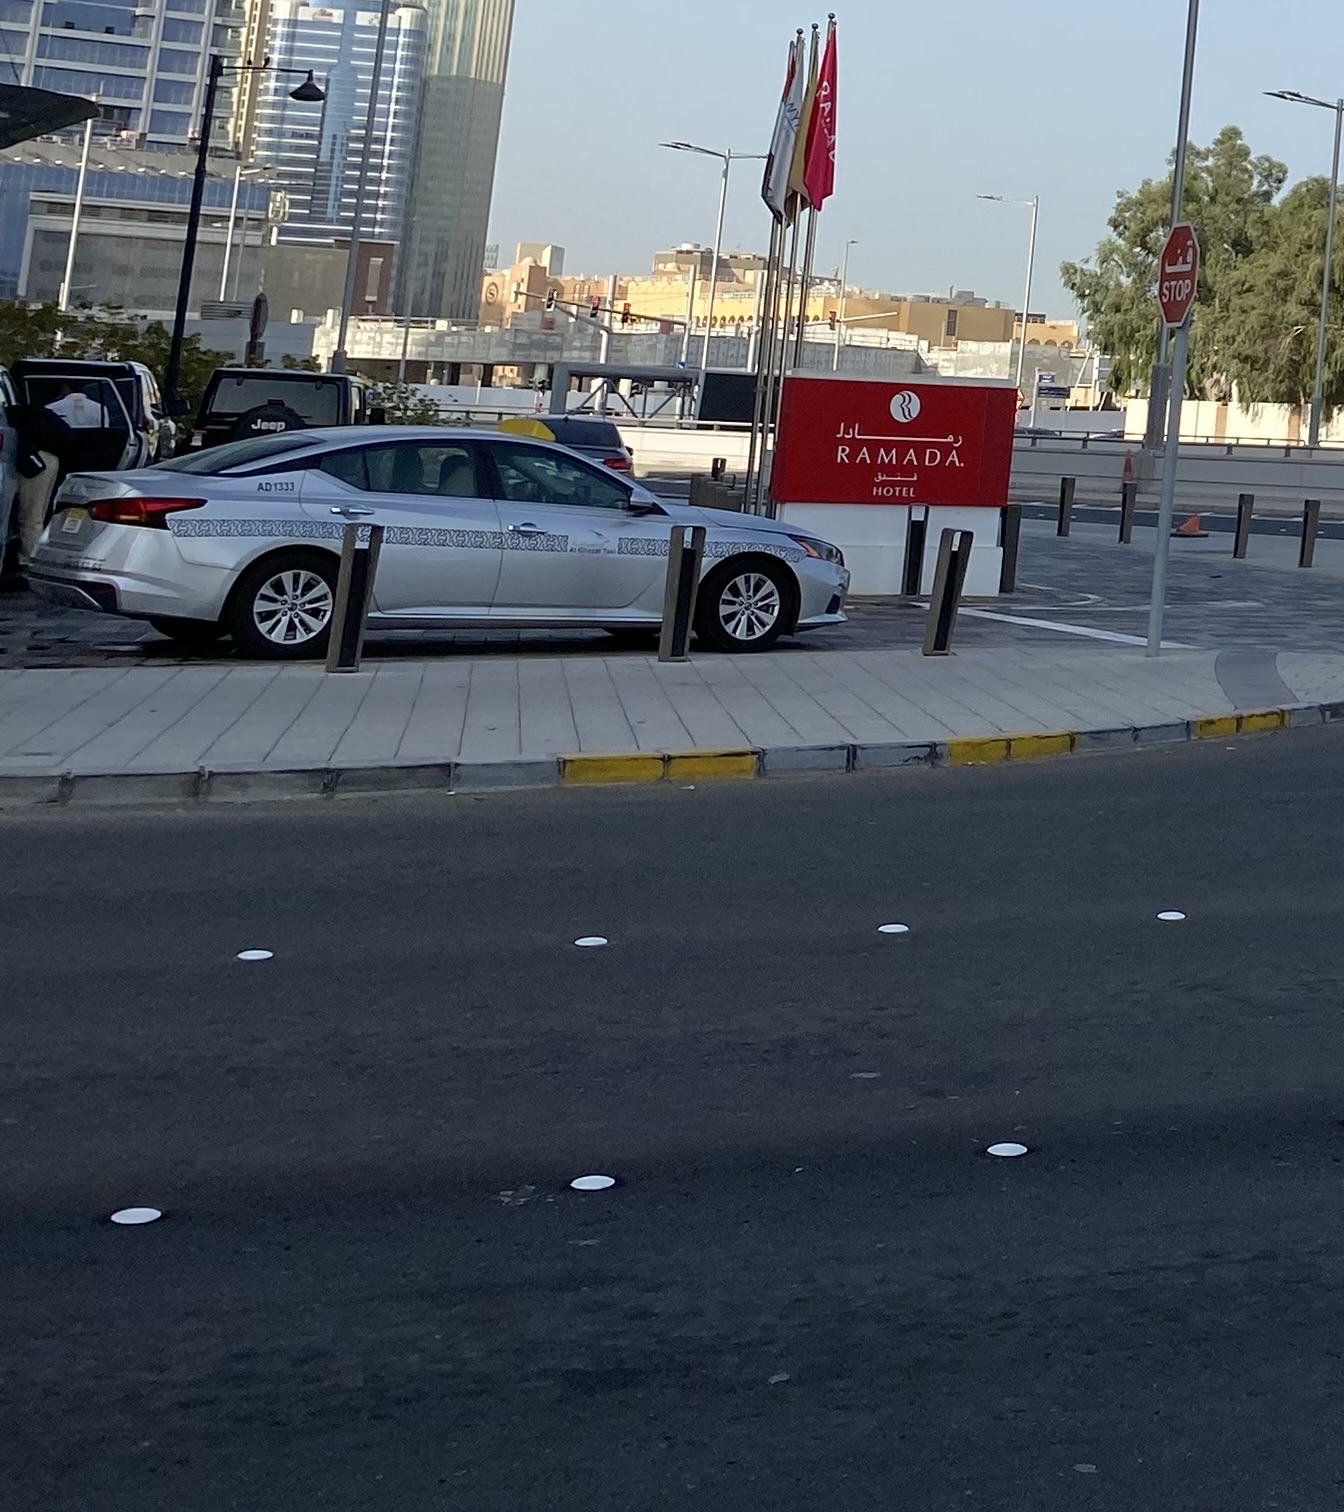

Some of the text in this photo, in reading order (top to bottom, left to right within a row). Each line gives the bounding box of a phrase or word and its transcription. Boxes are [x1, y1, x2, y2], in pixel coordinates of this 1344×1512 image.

[1165, 239, 1194, 274] قف
[1162, 279, 1192, 303] STOP
[251, 419, 286, 432] Jeep
[874, 472, 918, 482] فندق
[257, 482, 295, 492] AD1333
[873, 486, 916, 497] HOTEL
